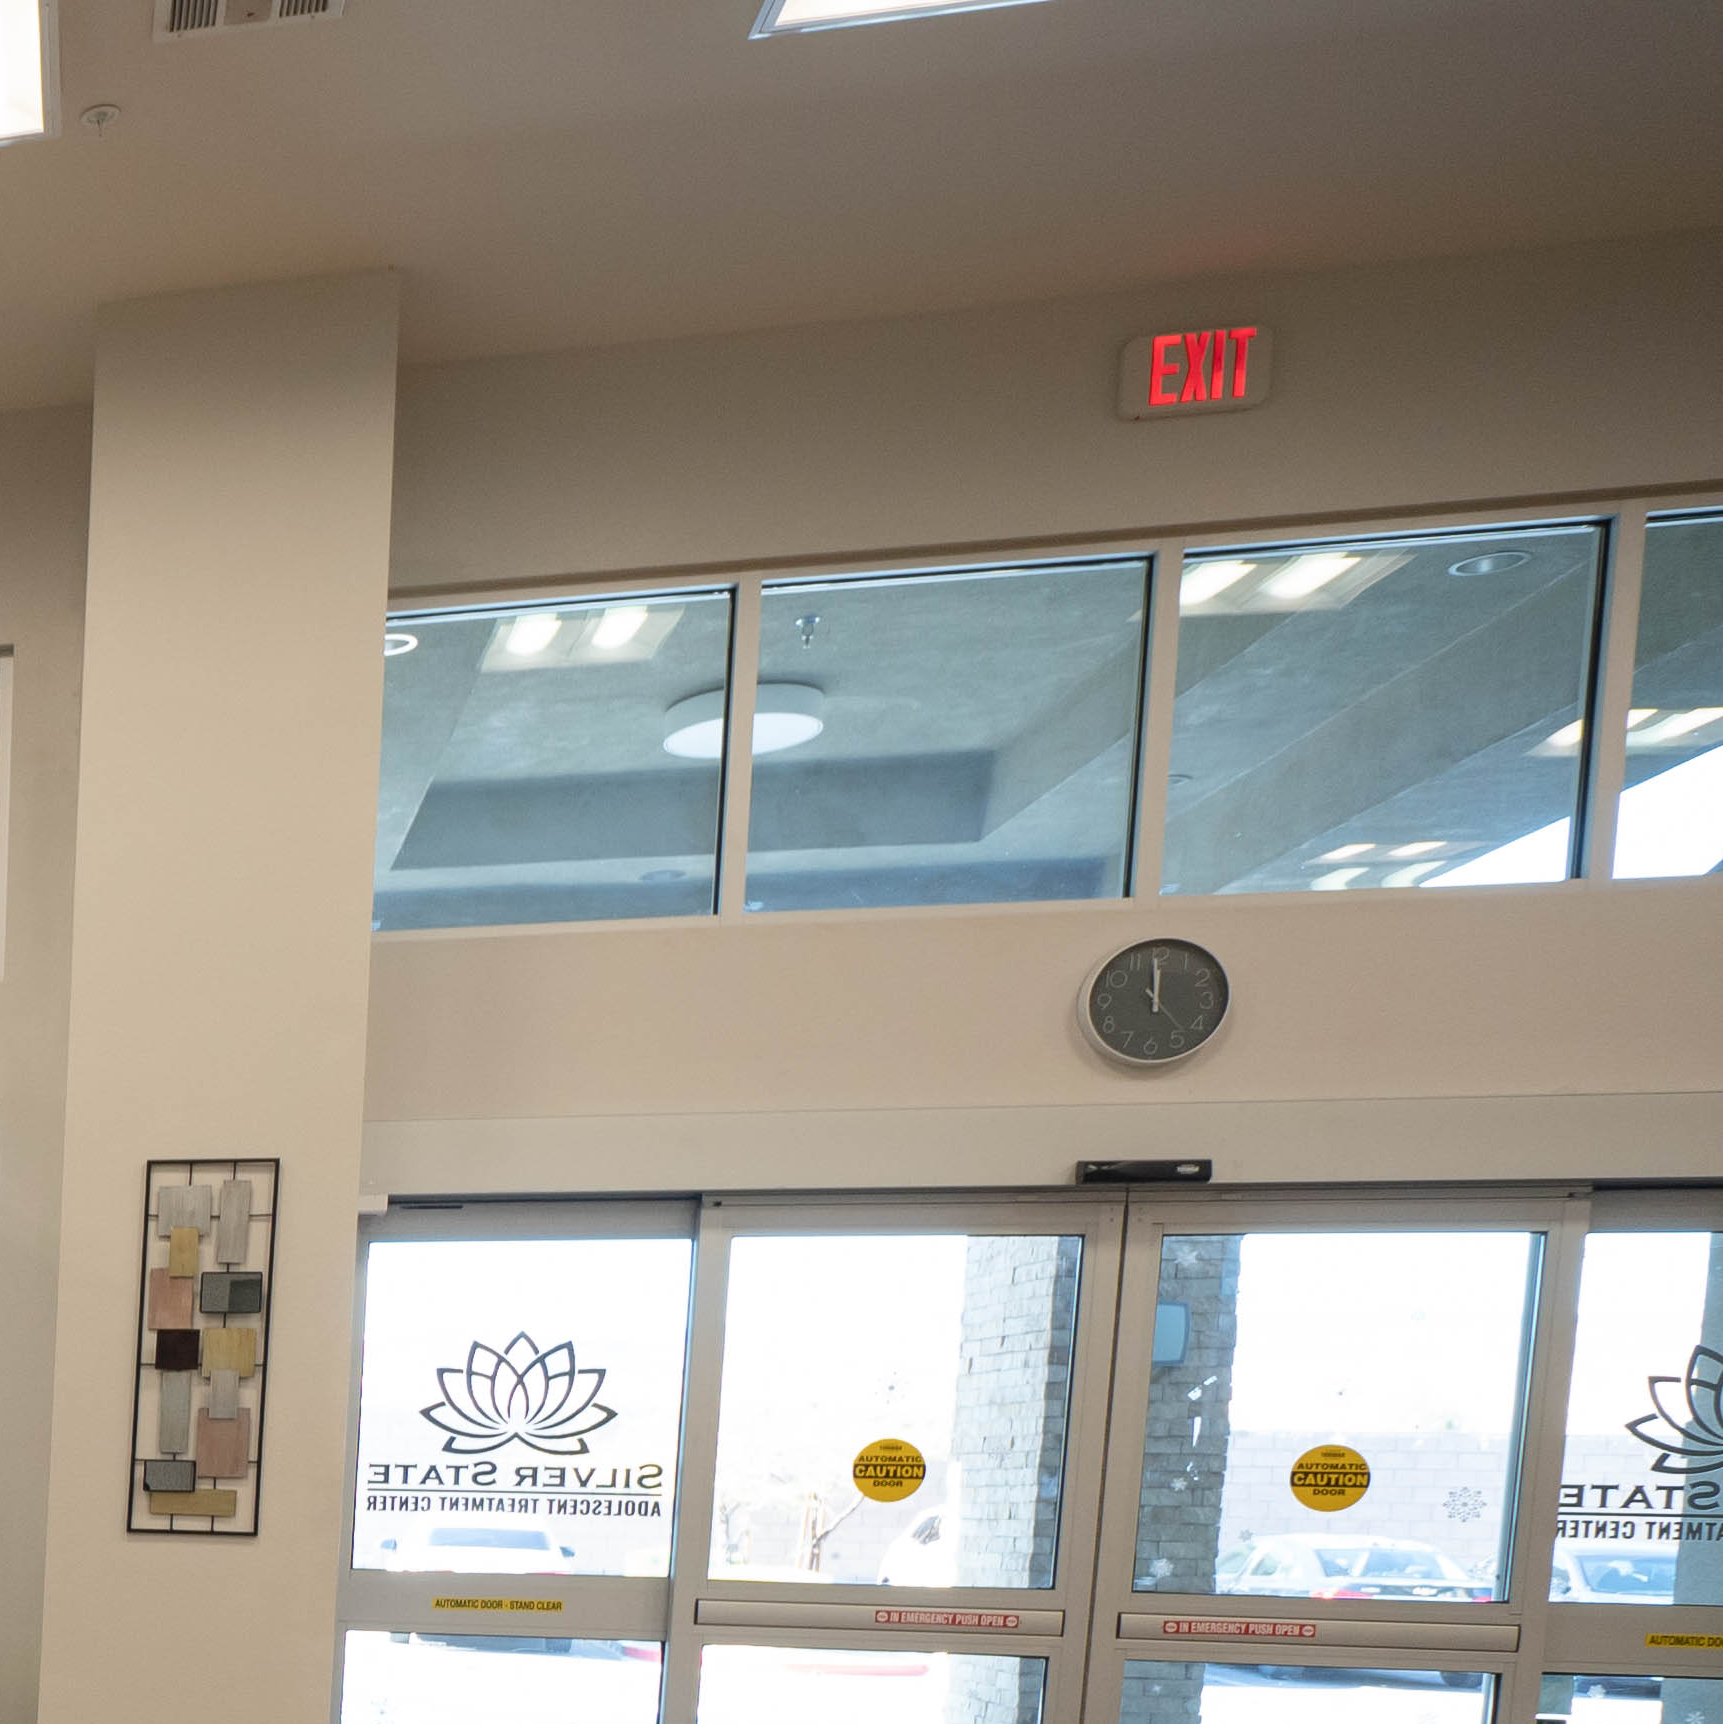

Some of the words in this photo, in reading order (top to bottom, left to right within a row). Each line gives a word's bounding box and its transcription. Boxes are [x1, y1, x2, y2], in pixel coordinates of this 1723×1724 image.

[1149, 327, 1257, 406] EXIT
[1130, 953, 1140, 971] 11
[1105, 970, 1127, 988] 10
[1195, 968, 1211, 987] 2
[1097, 993, 1112, 1010] 9
[1200, 992, 1213, 1009] 3
[1103, 1016, 1114, 1033] 8
[1190, 1015, 1204, 1030] 4
[1120, 1031, 1134, 1049] 7
[1144, 1038, 1157, 1055] 6
[1170, 1030, 1185, 1048] 5
[855, 1465, 924, 1477] CAUTION
[1294, 1473, 1368, 1486] CAUTION
[435, 1599, 479, 1608] AUTOMATIC
[481, 1600, 503, 1609] DOOR
[510, 1601, 534, 1610] STAND
[537, 1601, 562, 1610] CLEAR
[891, 1612, 899, 1622] IN
[901, 1612, 954, 1624] EMERGENCY
[955, 1614, 979, 1624] PUSH
[981, 1614, 1004, 1625] OPEN
[1179, 1622, 1189, 1632] IN
[1191, 1622, 1246, 1634] EMERGENCY
[1249, 1623, 1274, 1634] PUSH
[1275, 1624, 1299, 1635] OPEN
[1650, 1635, 1706, 1646] AUTOMATIC
